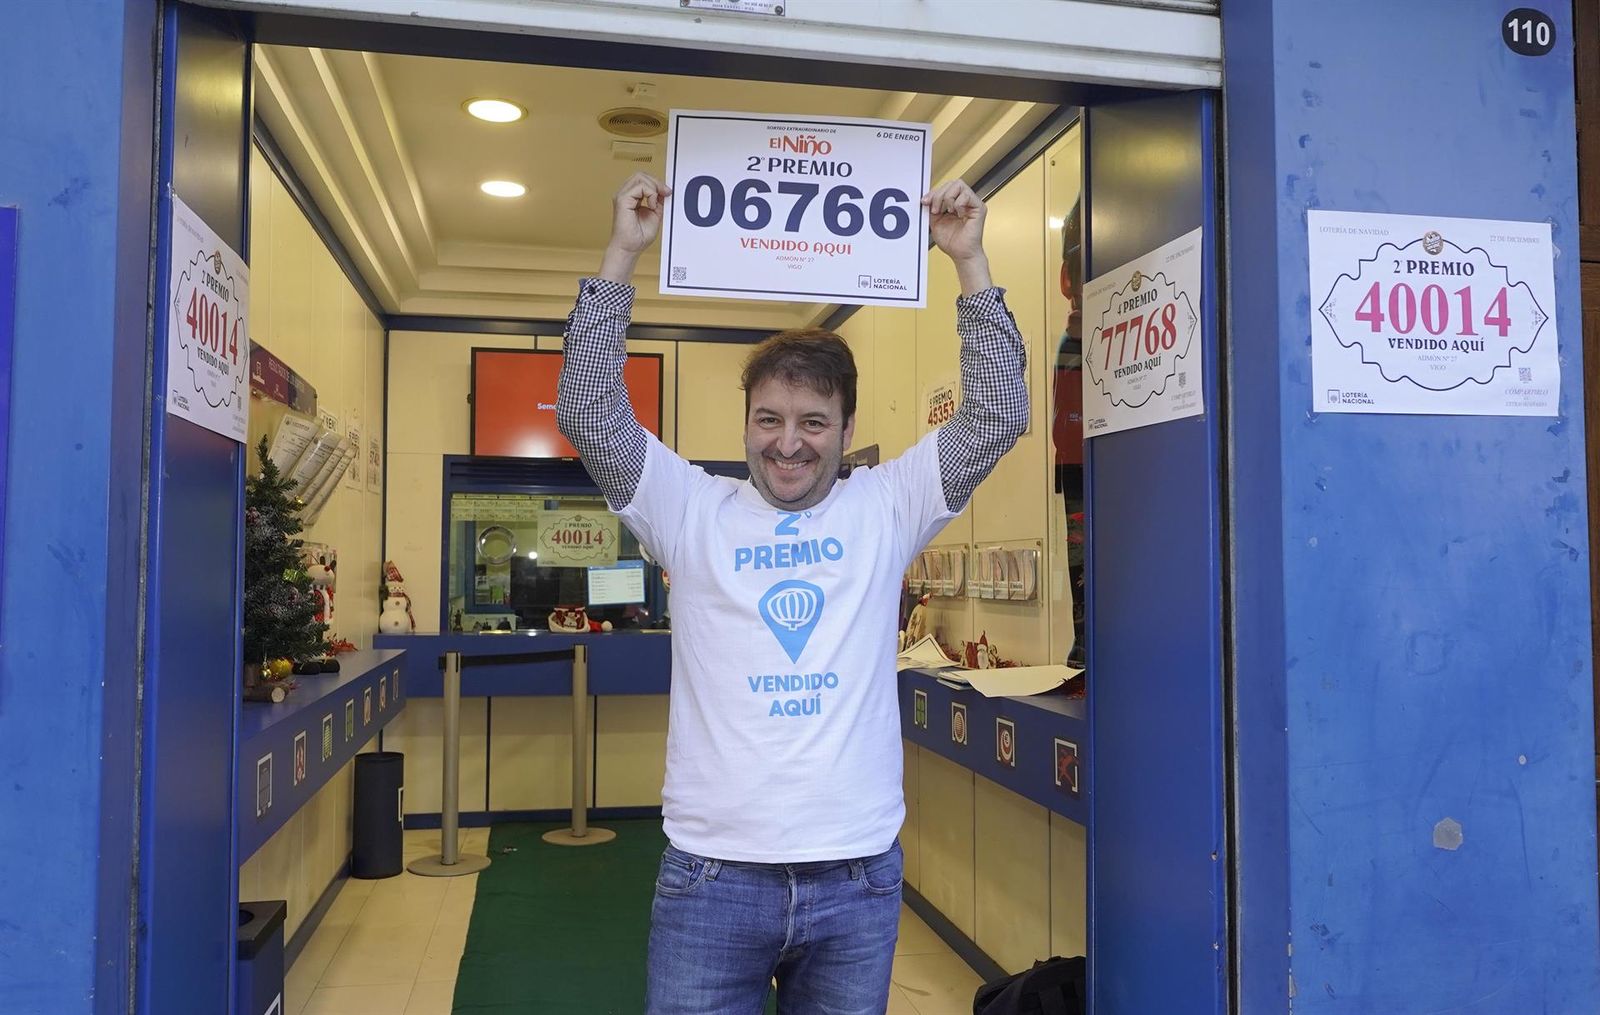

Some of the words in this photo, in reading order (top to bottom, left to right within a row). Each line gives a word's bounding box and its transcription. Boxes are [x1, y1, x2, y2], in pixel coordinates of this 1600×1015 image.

[1508, 18, 1550, 46] 110
[769, 137, 781, 149] El
[782, 134, 832, 156] Niño
[894, 132, 920, 142] ENERO
[767, 157, 853, 178] PREMIO
[683, 175, 910, 240] 06766
[1348, 227, 1357, 235] DE
[1358, 228, 1390, 236] NAVIDAD
[740, 237, 809, 252] VENDIDO
[1406, 259, 1475, 276] PREMIO
[206, 272, 230, 303] PREMIO
[873, 277, 901, 285] LOTERÍA
[1123, 288, 1158, 313] PREMIO
[1354, 281, 1512, 337] 40014
[186, 286, 239, 366] 40014
[1101, 302, 1177, 370] 77768
[197, 346, 218, 369] VENDIDO
[1388, 337, 1448, 351] VENDIDO
[1451, 337, 1485, 354] AQUÍ
[1114, 362, 1142, 379] VENDIDO
[1143, 353, 1162, 371] AQUÍ
[927, 400, 955, 427] 45353
[551, 529, 604, 545] 40014
[734, 536, 844, 572] PREMIO
[747, 671, 839, 693] VENDIDO
[768, 692, 822, 717] AQUÍ
